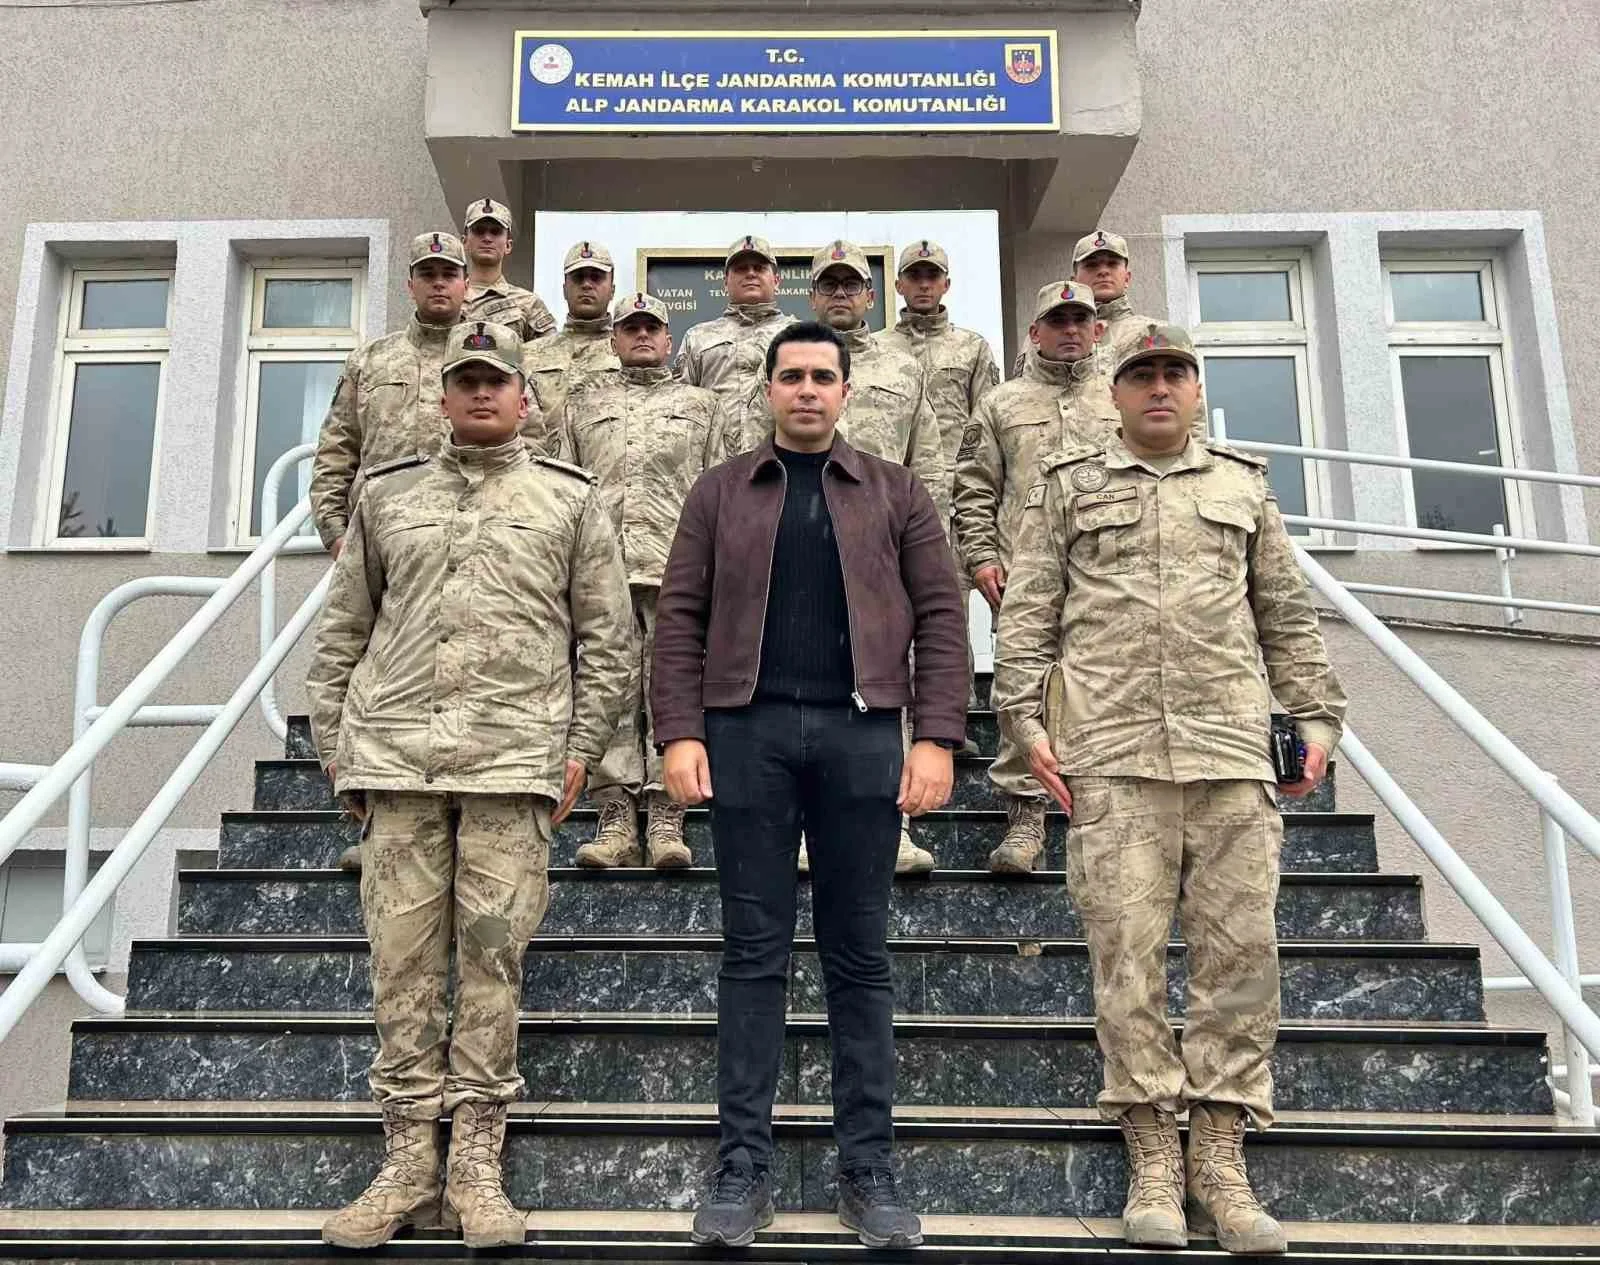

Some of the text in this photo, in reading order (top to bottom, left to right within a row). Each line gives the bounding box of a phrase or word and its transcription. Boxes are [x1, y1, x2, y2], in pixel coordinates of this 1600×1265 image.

[765, 48, 805, 63] T.C.
[574, 72, 654, 88] KEMAH
[661, 70, 710, 91] İLÇE
[716, 73, 836, 88] JANDARMA
[843, 69, 996, 88] KOMUTANLIĞI
[565, 94, 1006, 113] ALP JANDARMA KARAKOL KOMUTANLIĞI
[656, 288, 693, 298] VATAN
[1096, 493, 1115, 501] CAN
